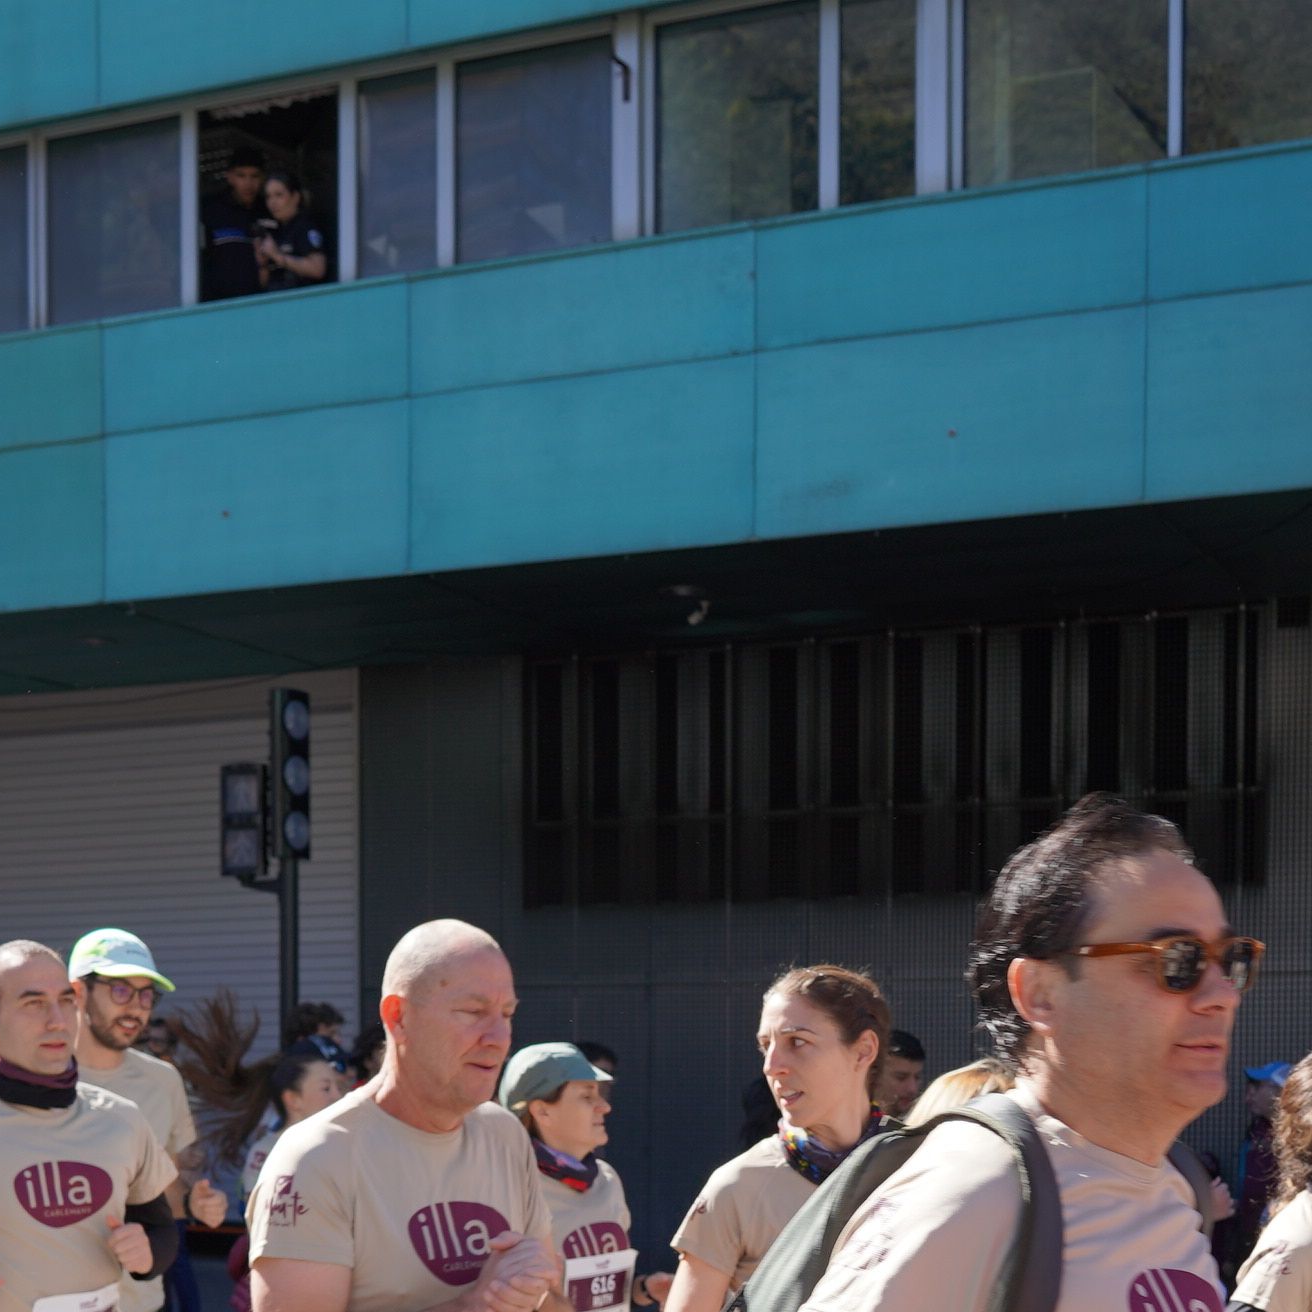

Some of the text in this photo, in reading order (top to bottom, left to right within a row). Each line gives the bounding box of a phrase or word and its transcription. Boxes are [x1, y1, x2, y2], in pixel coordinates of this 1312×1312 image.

[23, 1161, 92, 1209] illa
[416, 1202, 491, 1260] illa
[591, 1274, 616, 1295] 616
